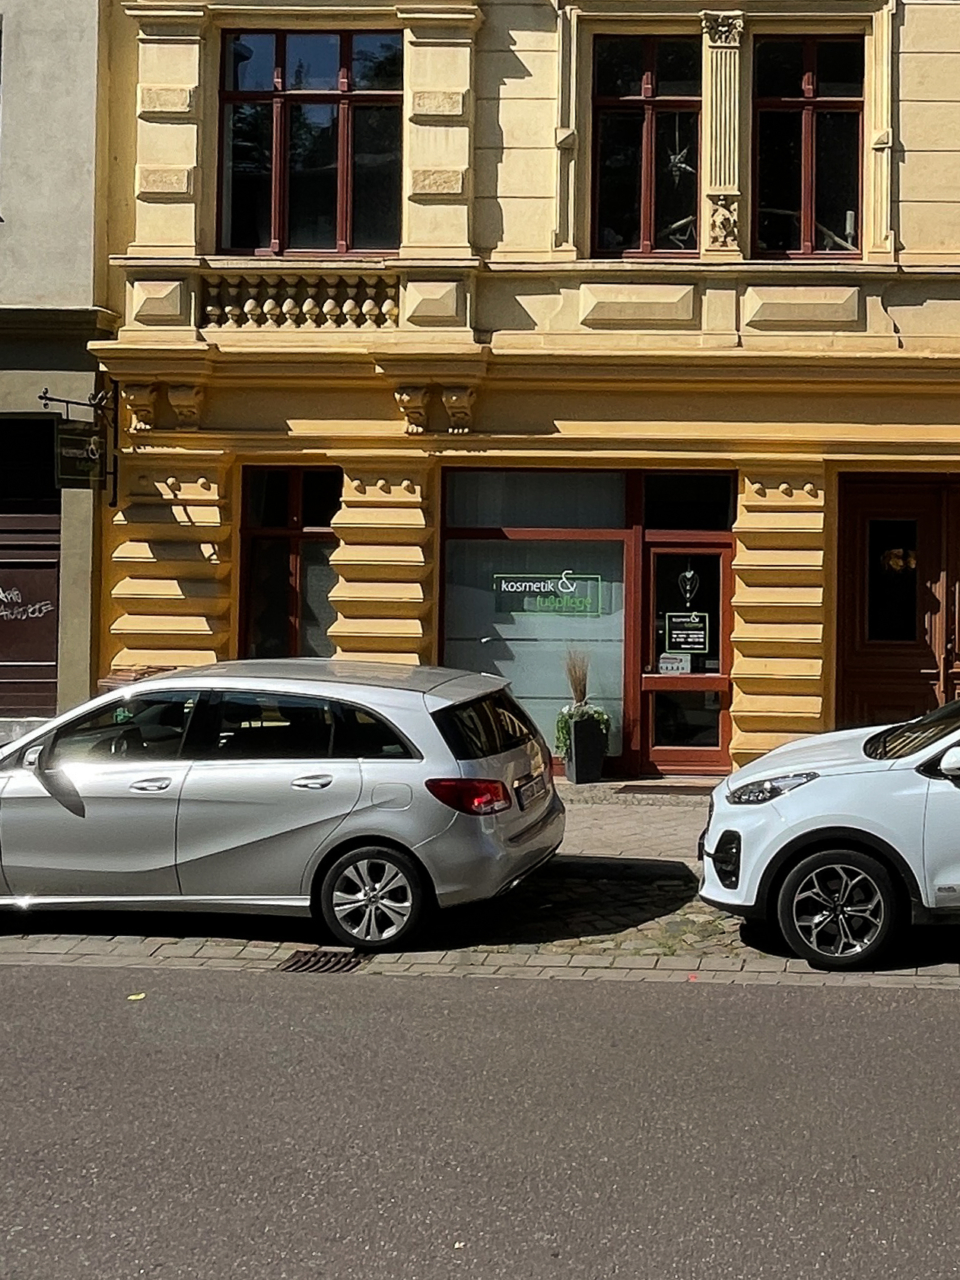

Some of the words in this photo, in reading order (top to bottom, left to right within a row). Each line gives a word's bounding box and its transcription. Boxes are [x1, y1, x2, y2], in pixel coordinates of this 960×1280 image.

[501, 580, 555, 592] kosmetik
[558, 570, 577, 593] &
[536, 595, 592, 611] fußpflege
